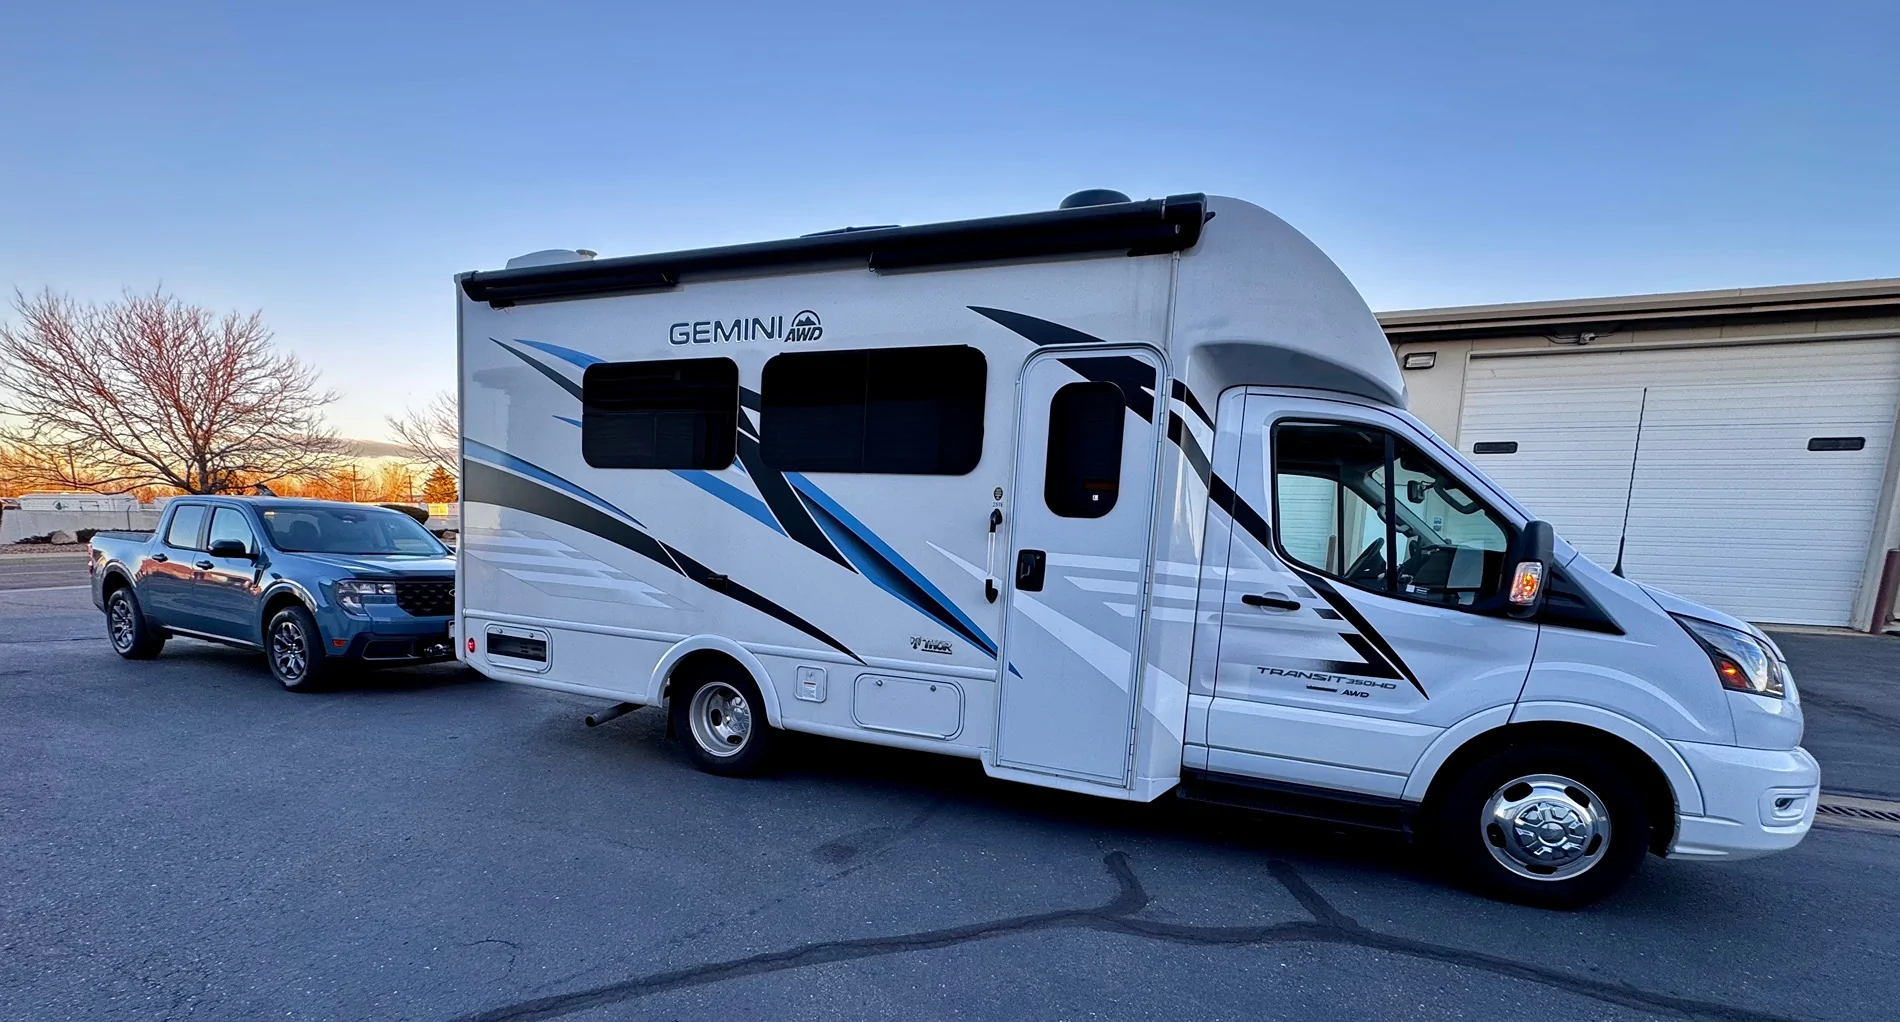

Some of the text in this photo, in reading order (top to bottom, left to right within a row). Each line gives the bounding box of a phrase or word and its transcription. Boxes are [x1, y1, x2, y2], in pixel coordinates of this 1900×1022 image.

[669, 315, 823, 345] GEMINI AWD
[922, 639, 953, 652] THOR
[1341, 689, 1370, 698] AWD
